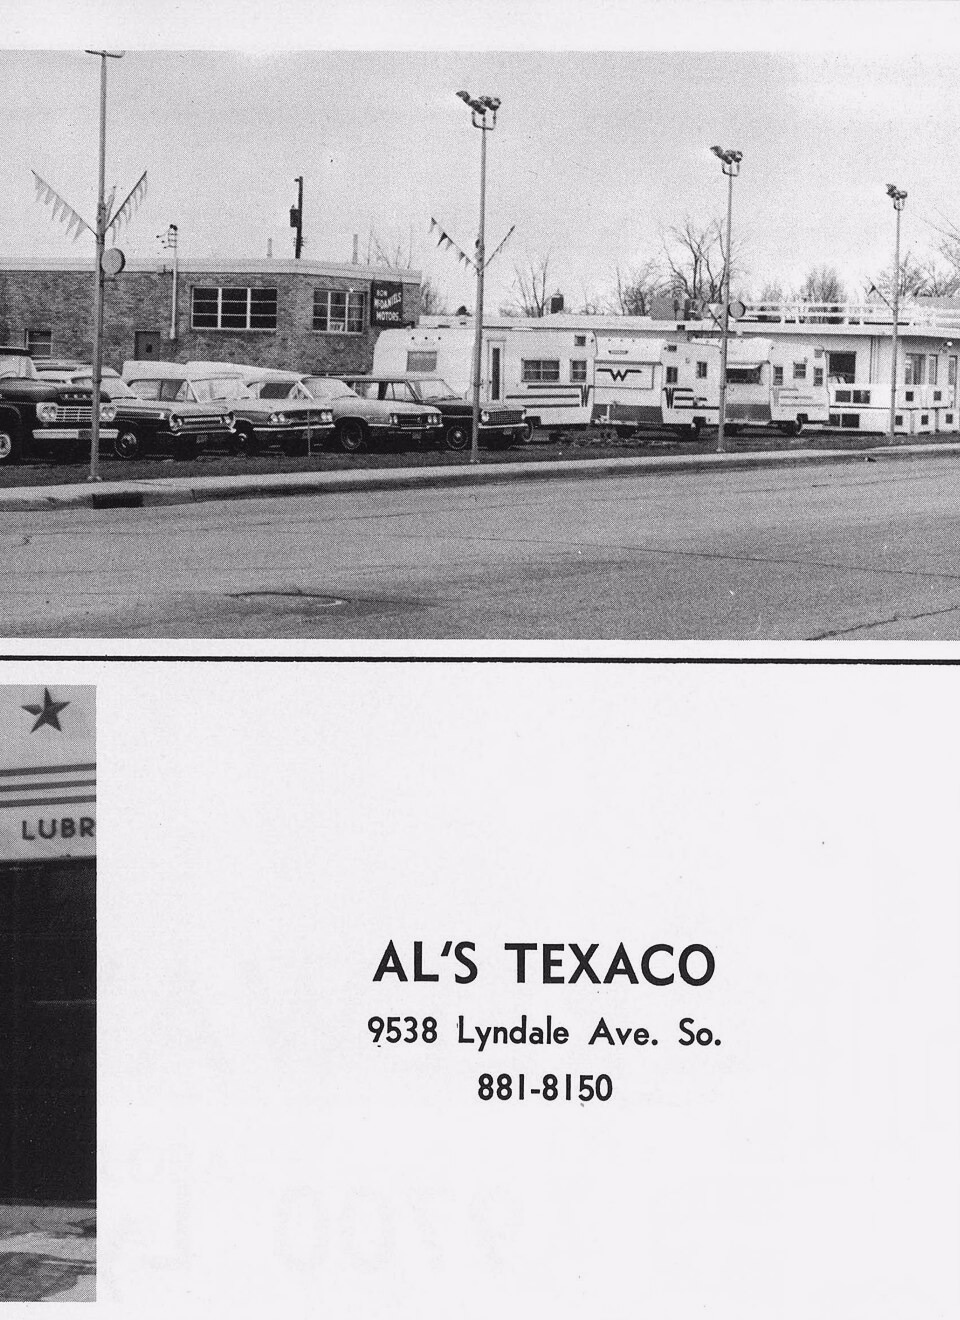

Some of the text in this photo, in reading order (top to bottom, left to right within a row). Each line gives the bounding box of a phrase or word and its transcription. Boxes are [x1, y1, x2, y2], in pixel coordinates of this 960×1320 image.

[21, 816, 96, 841] LUBR
[373, 940, 715, 986] AL'S TEXACO
[368, 1015, 721, 1051] 9538 Lyndale Ave. So.
[478, 1074, 612, 1101] 881-8150
